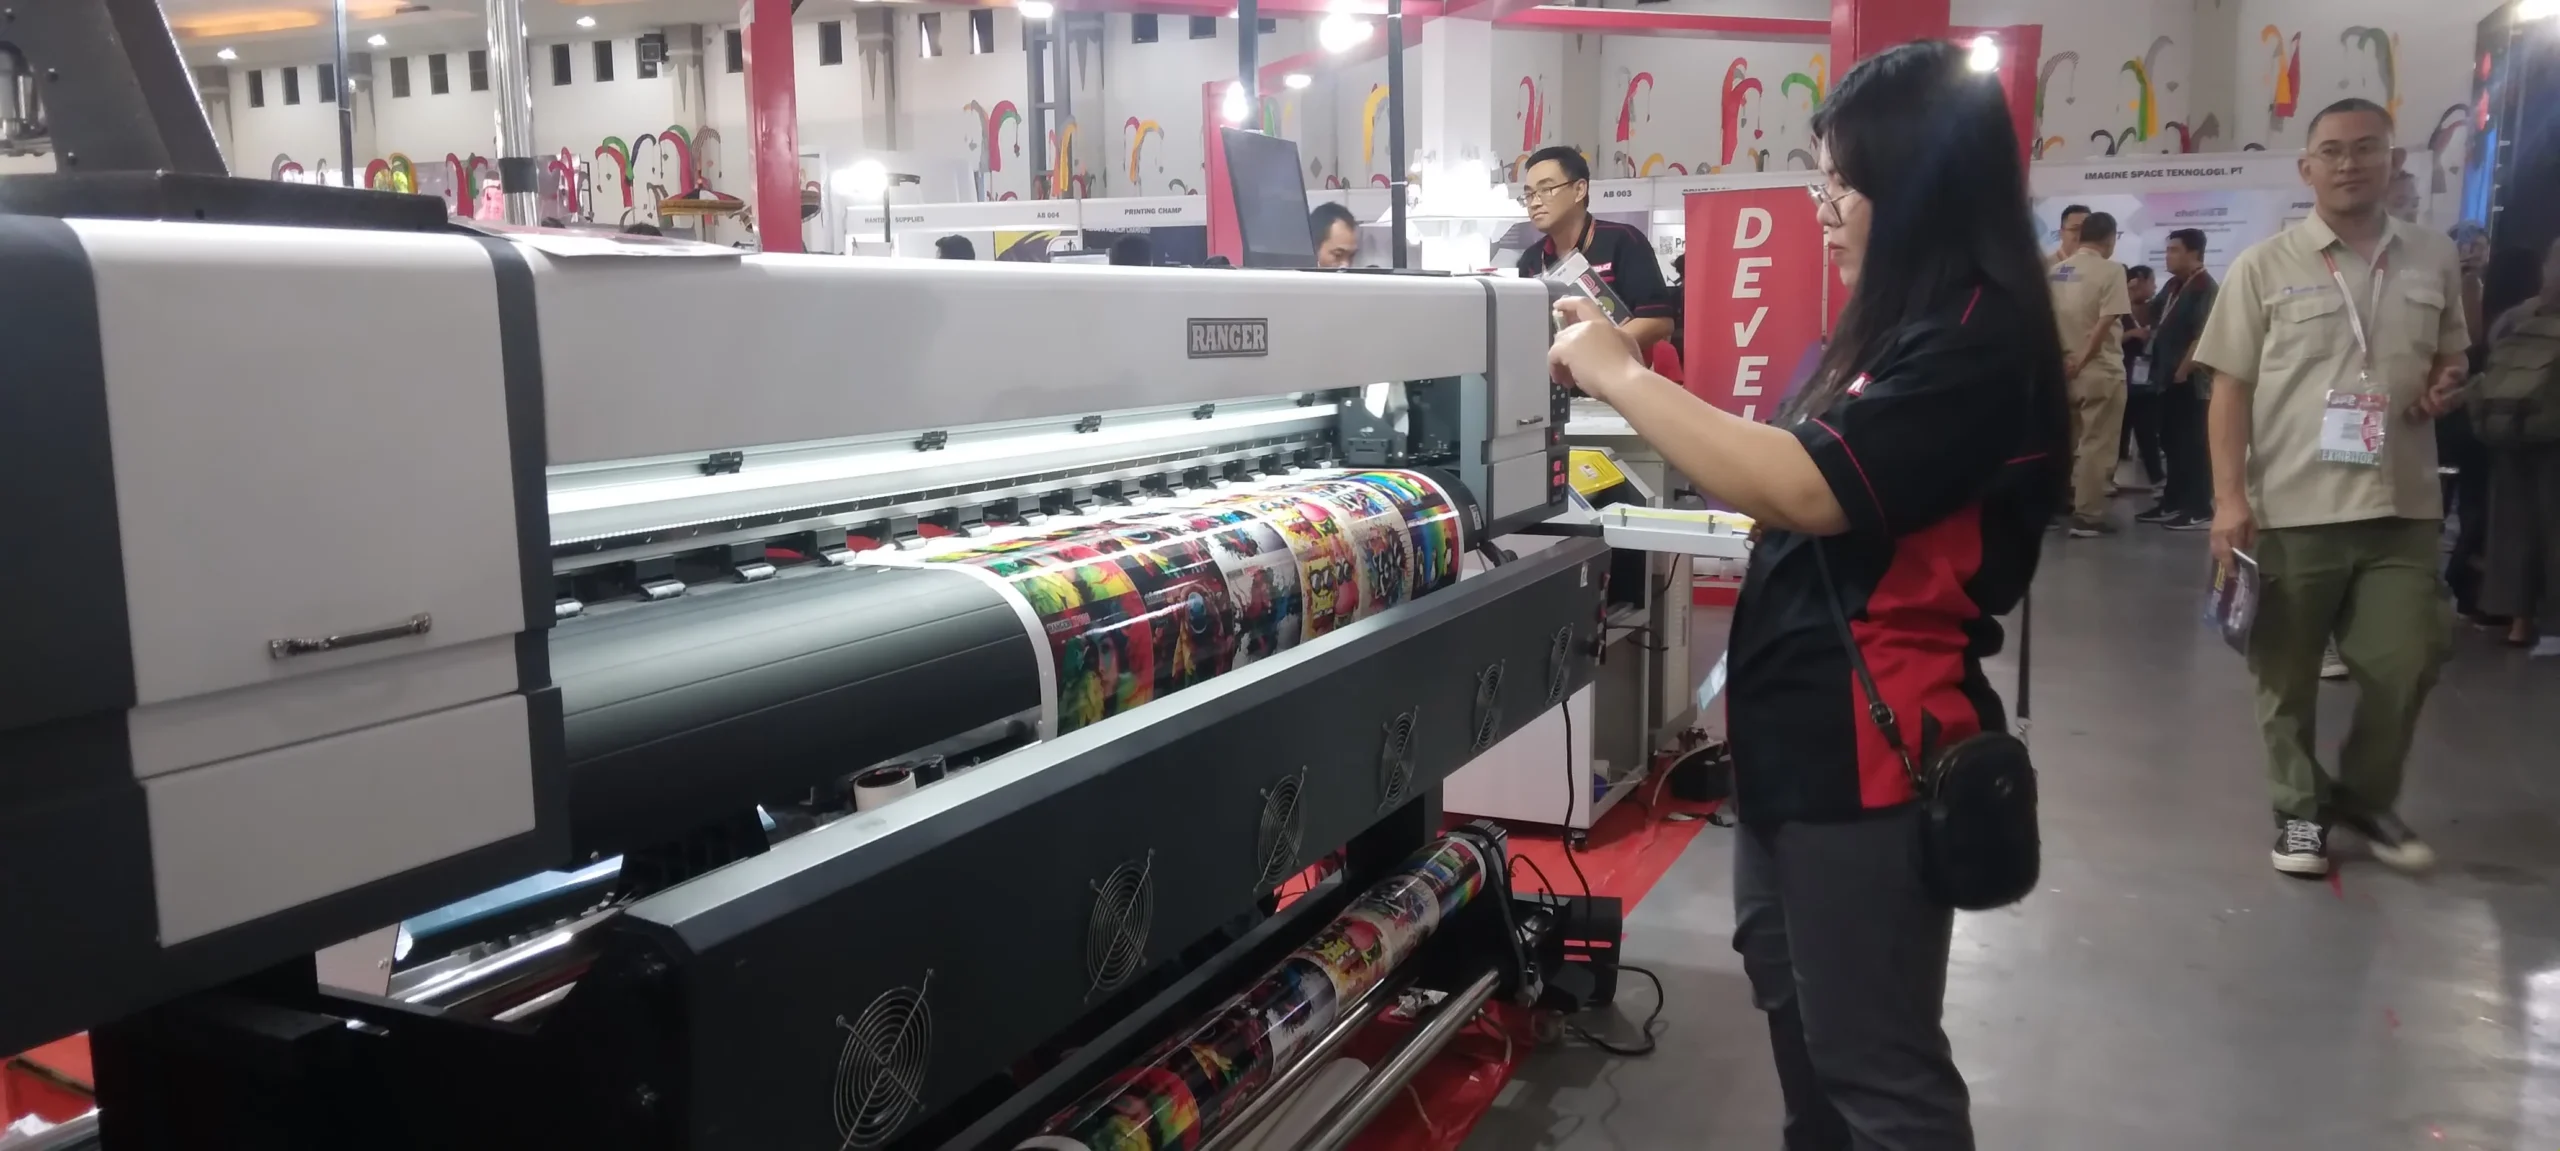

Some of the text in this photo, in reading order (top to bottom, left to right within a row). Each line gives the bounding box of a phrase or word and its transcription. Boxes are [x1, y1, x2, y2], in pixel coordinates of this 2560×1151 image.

[2085, 170, 2128, 180] IMAGINE
[2130, 169, 2164, 179] SPACE
[2230, 166, 2243, 175] PT
[1037, 211, 1060, 219] AB 004
[1124, 206, 1182, 216] PRINTING CHAMP
[1191, 324, 1266, 352] RANGER
